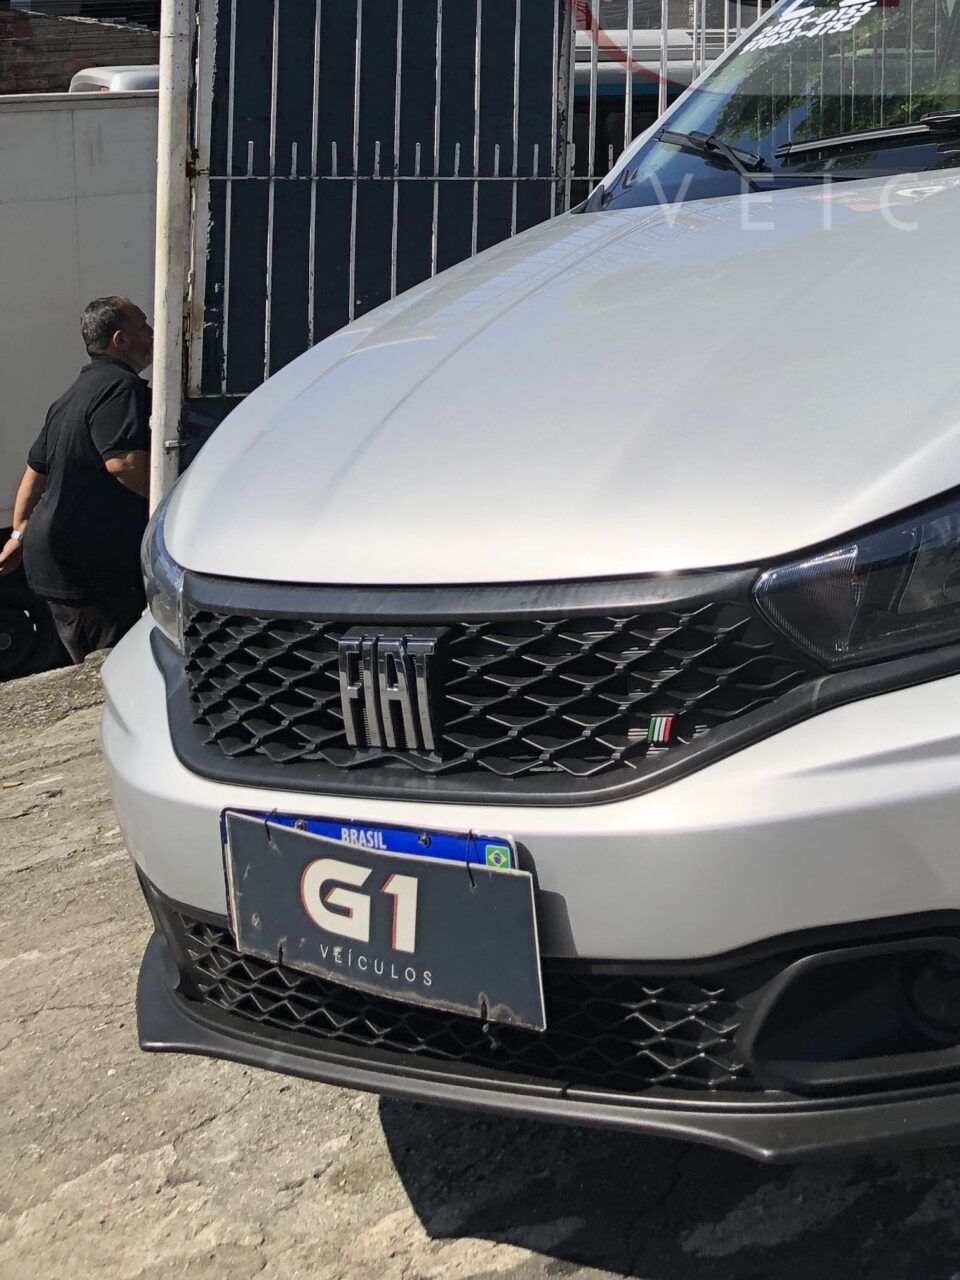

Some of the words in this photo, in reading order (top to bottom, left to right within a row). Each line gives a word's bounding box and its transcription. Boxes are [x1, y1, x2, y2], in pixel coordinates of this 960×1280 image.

[739, 16, 861, 55] 97023-4752
[752, 1, 877, 41] 2601-0155
[338, 640, 436, 751] FIAT
[341, 827, 387, 850] BRASIL
[301, 858, 419, 954] G1
[319, 943, 433, 986] VEÍCULOS
